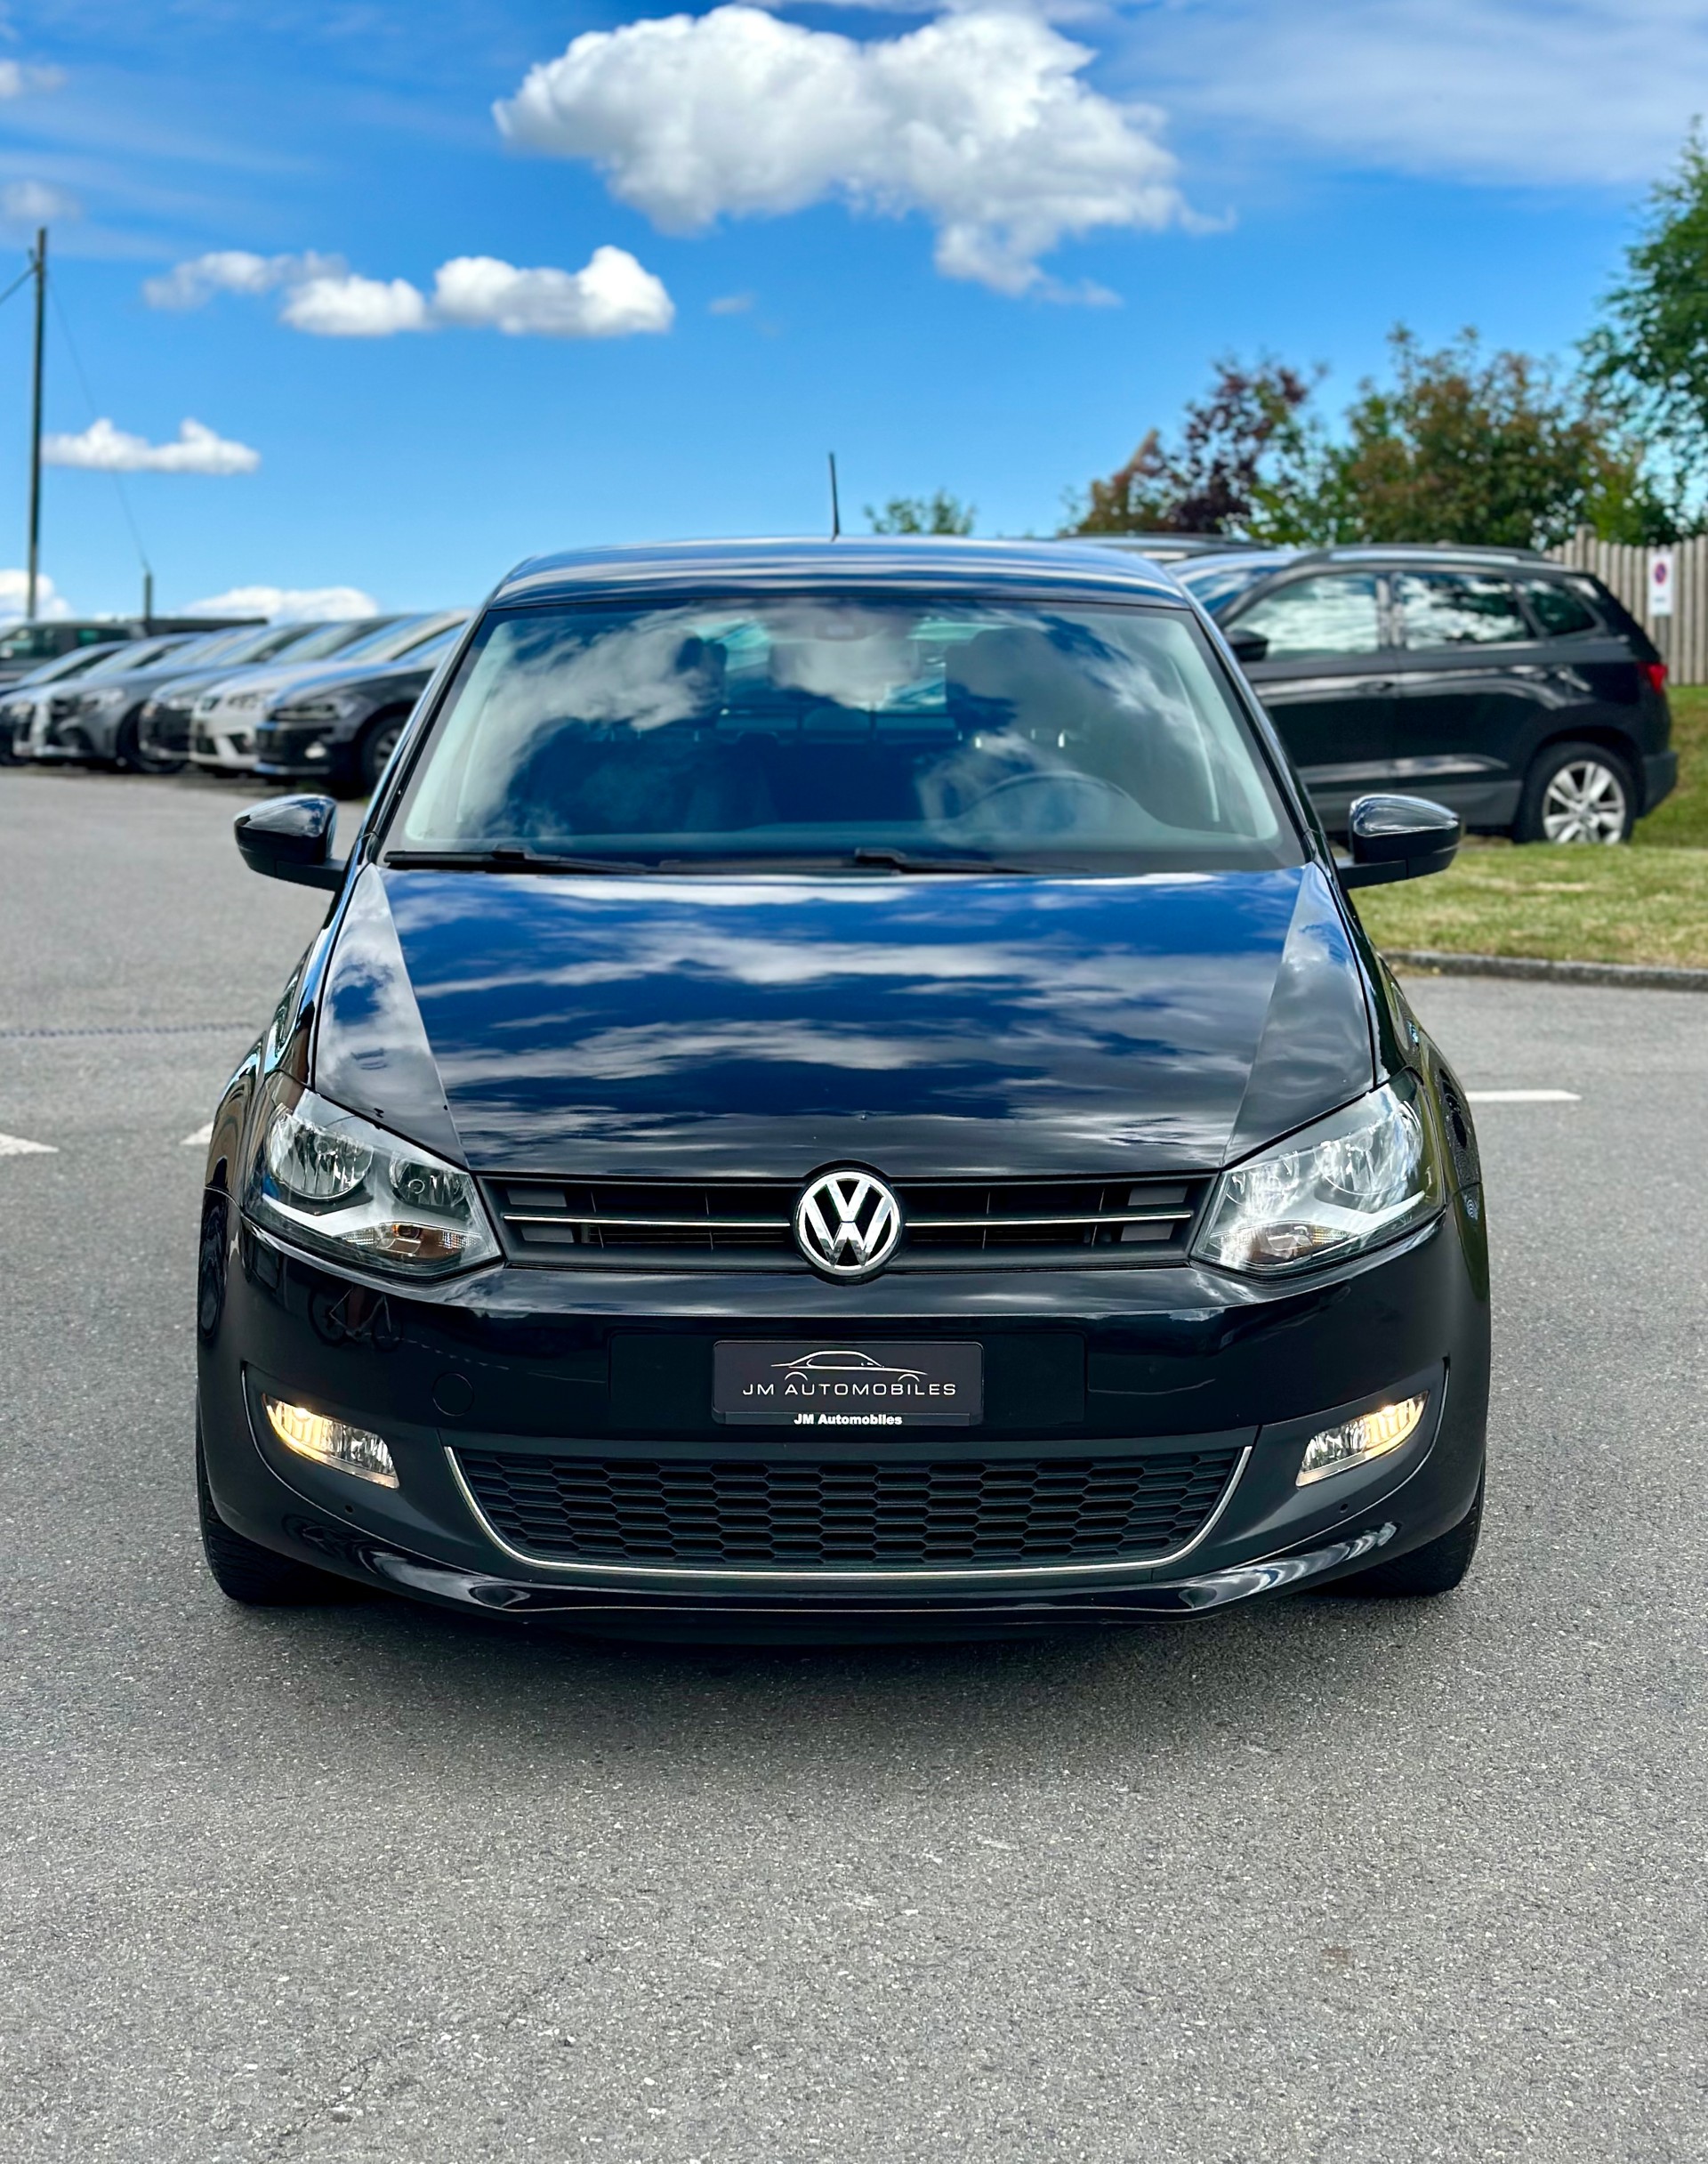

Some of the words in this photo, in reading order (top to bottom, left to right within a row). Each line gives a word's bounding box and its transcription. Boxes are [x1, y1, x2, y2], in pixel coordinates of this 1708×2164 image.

[742, 1383, 775, 1396] JM
[784, 1383, 957, 1396] AUTOMOBILES
[794, 1413, 815, 1425] JM
[818, 1413, 903, 1425] Automobiles
